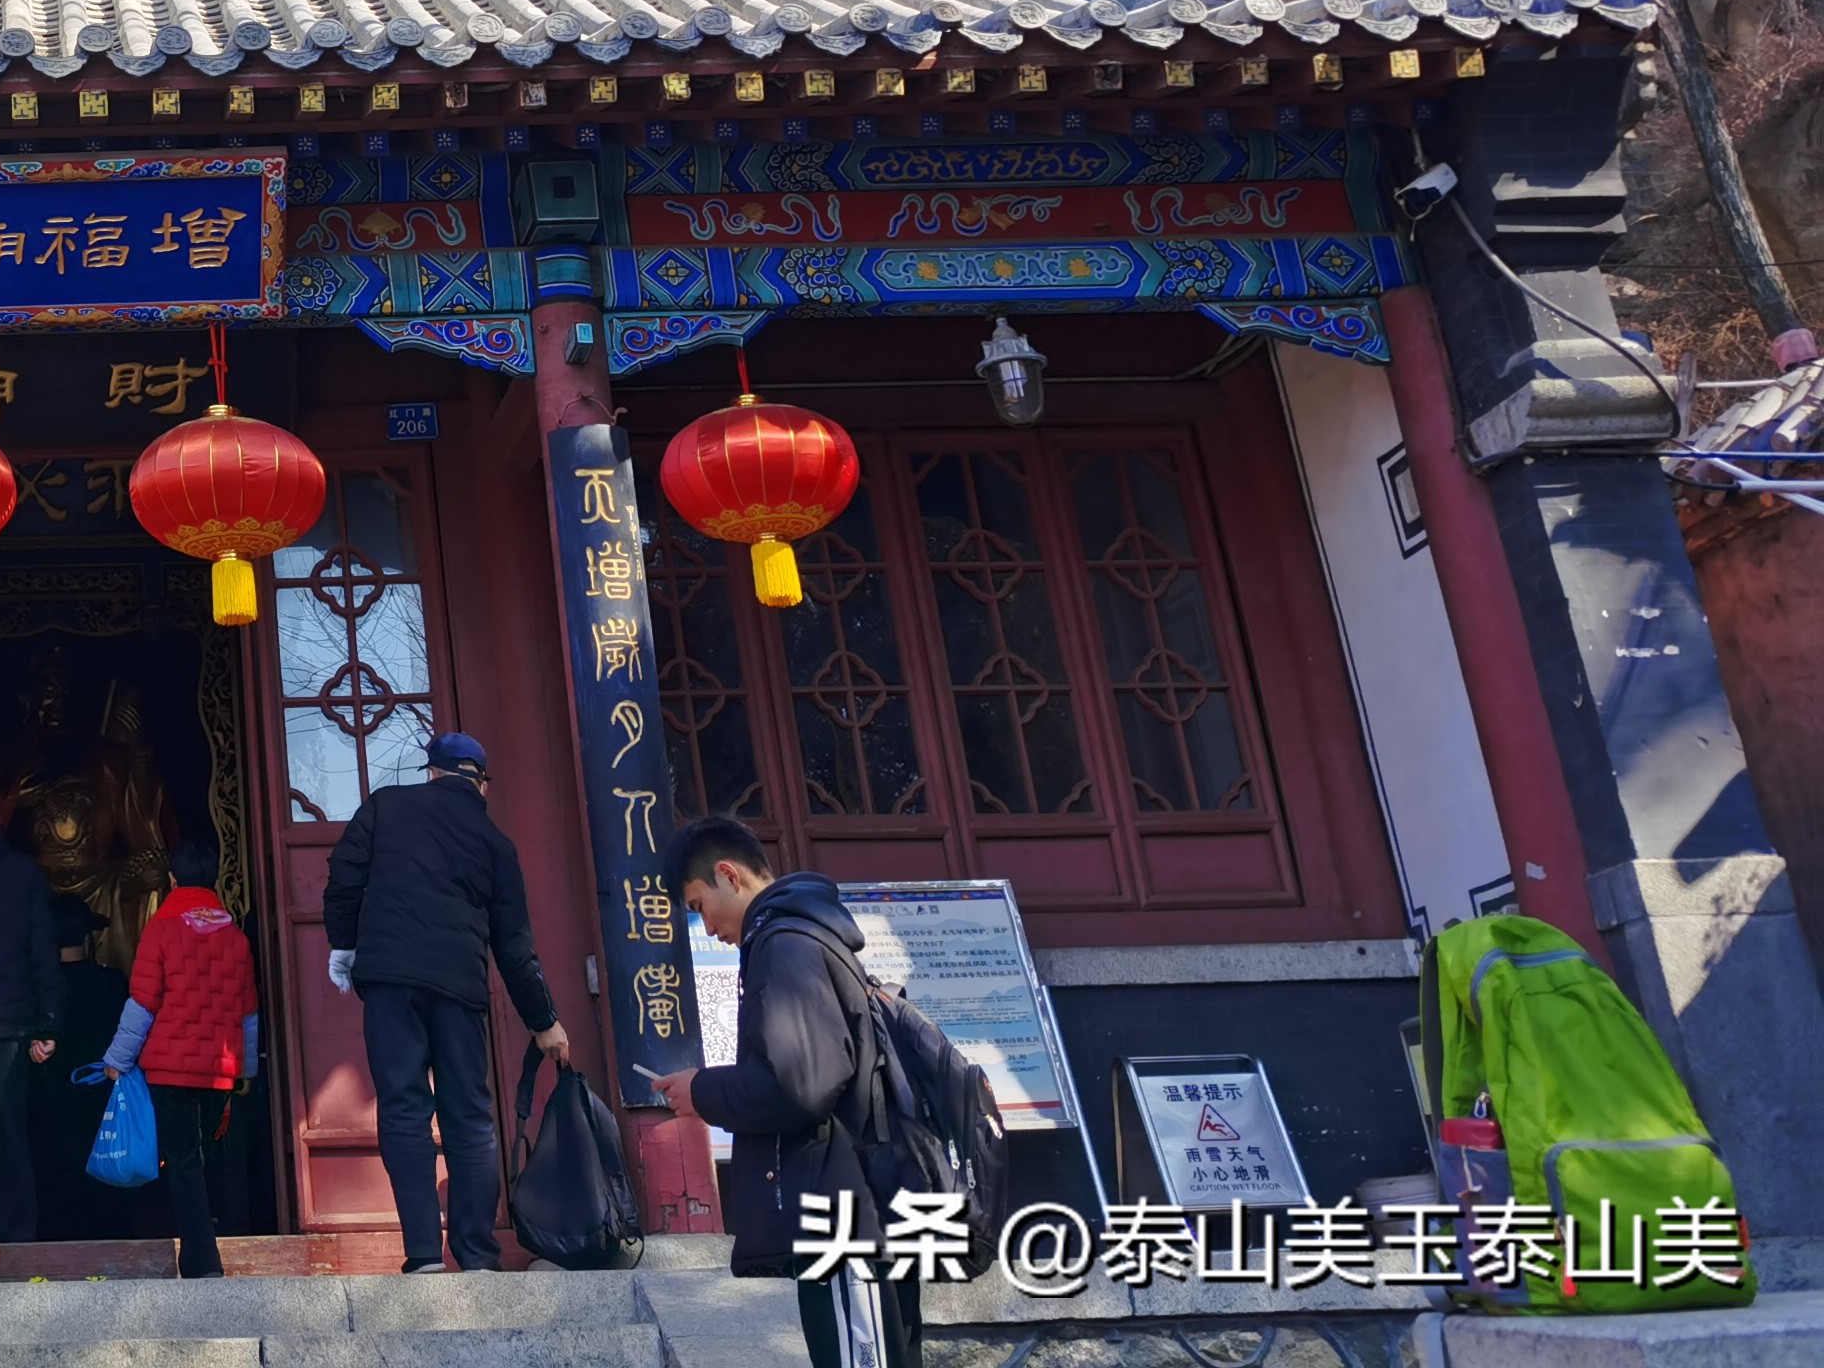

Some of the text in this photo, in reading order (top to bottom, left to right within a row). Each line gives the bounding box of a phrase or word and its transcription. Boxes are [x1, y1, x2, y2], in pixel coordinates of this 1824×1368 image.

[397, 420, 427, 435] 206
[1162, 1082, 1243, 1103] 温馨提示
[1183, 1145, 1265, 1164] 雨雪天气
[1192, 1164, 1271, 1183] 小心地滑
[1189, 1182, 1282, 1193] CAUTION WET FLOOR
